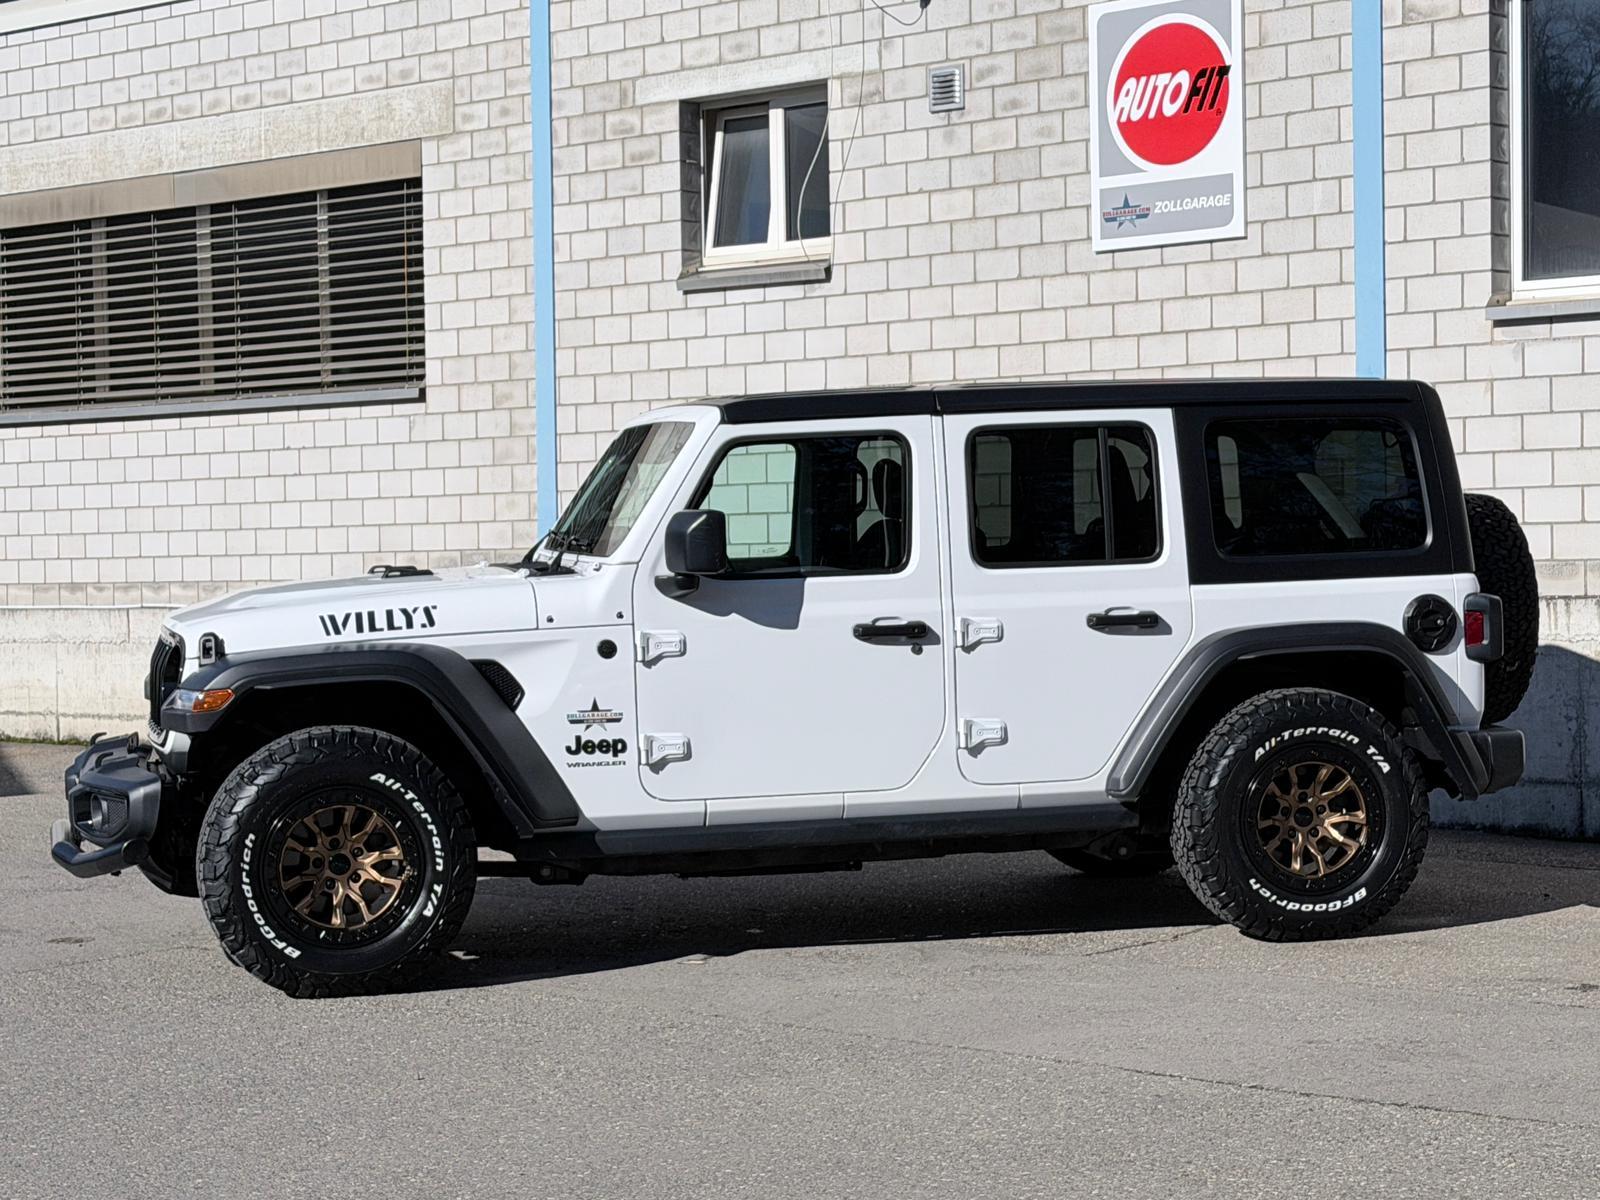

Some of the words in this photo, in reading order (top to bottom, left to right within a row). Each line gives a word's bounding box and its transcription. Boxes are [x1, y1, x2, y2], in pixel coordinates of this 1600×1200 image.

[1115, 65, 1231, 123] AUTOFIT
[1154, 194, 1231, 214] ZOLLGARAGE
[318, 605, 438, 637] WILLYS
[565, 735, 627, 758] Jeep
[1254, 726, 1360, 762] All-Terrain
[1366, 745, 1391, 775] T/A
[566, 760, 626, 768] WRANGLER
[369, 772, 444, 872] All-Terrain
[422, 883, 443, 917] T/A
[240, 833, 302, 959] BFGoodrich
[1248, 878, 1368, 912] BFGoodrich
